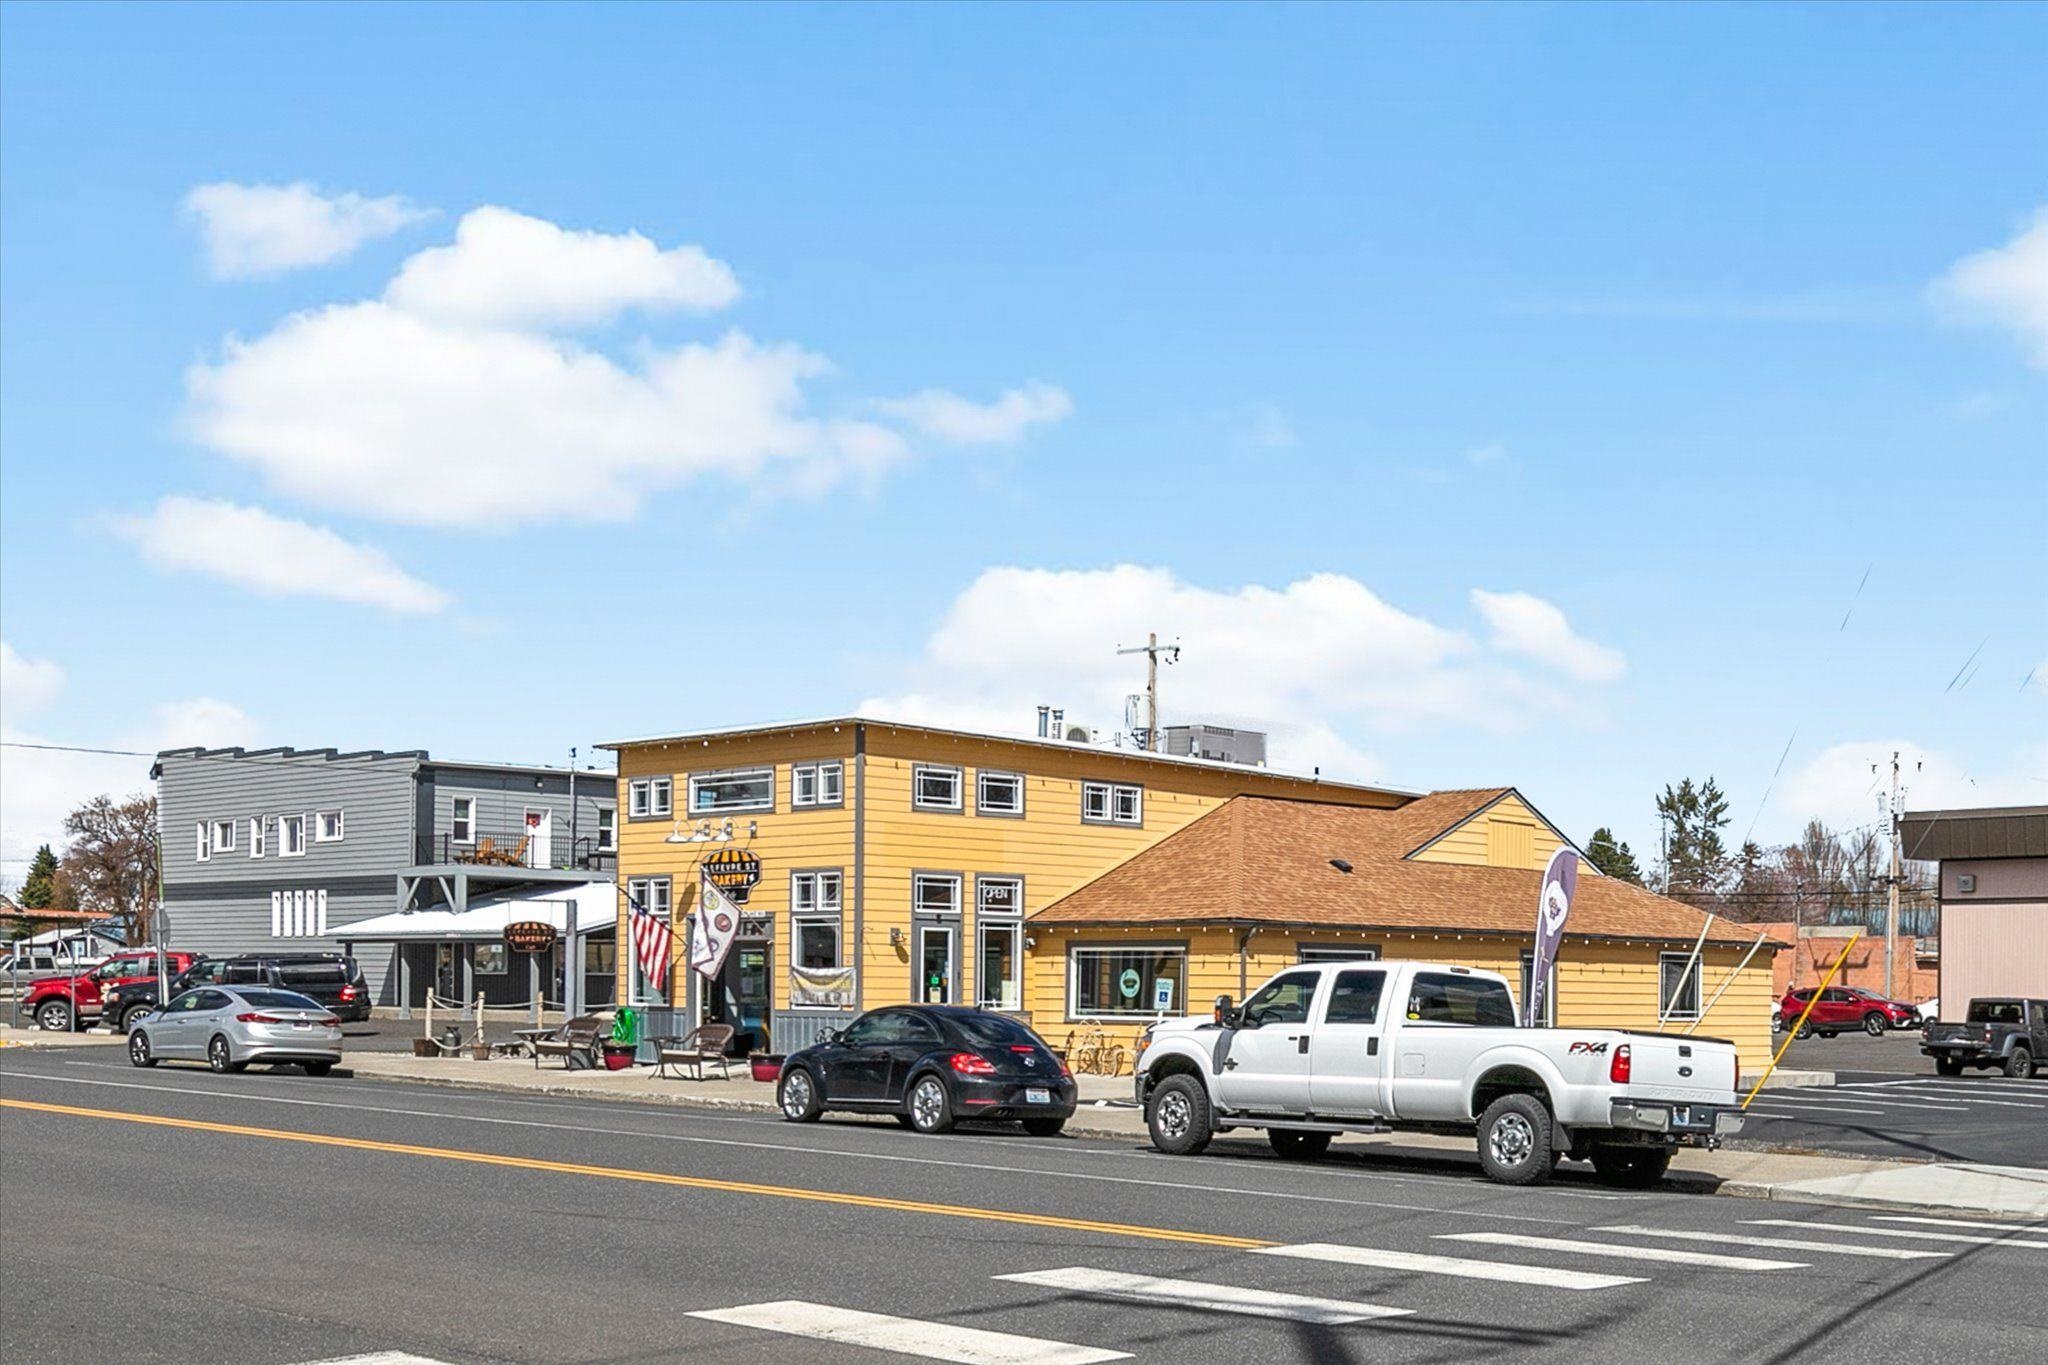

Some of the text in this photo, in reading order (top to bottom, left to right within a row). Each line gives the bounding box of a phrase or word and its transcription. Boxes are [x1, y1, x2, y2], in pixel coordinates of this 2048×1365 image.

[745, 862, 756, 870] ST
[712, 873, 748, 886] BAKERY
[985, 887, 1008, 898] OPEN
[1569, 1042, 1609, 1053] FX4
